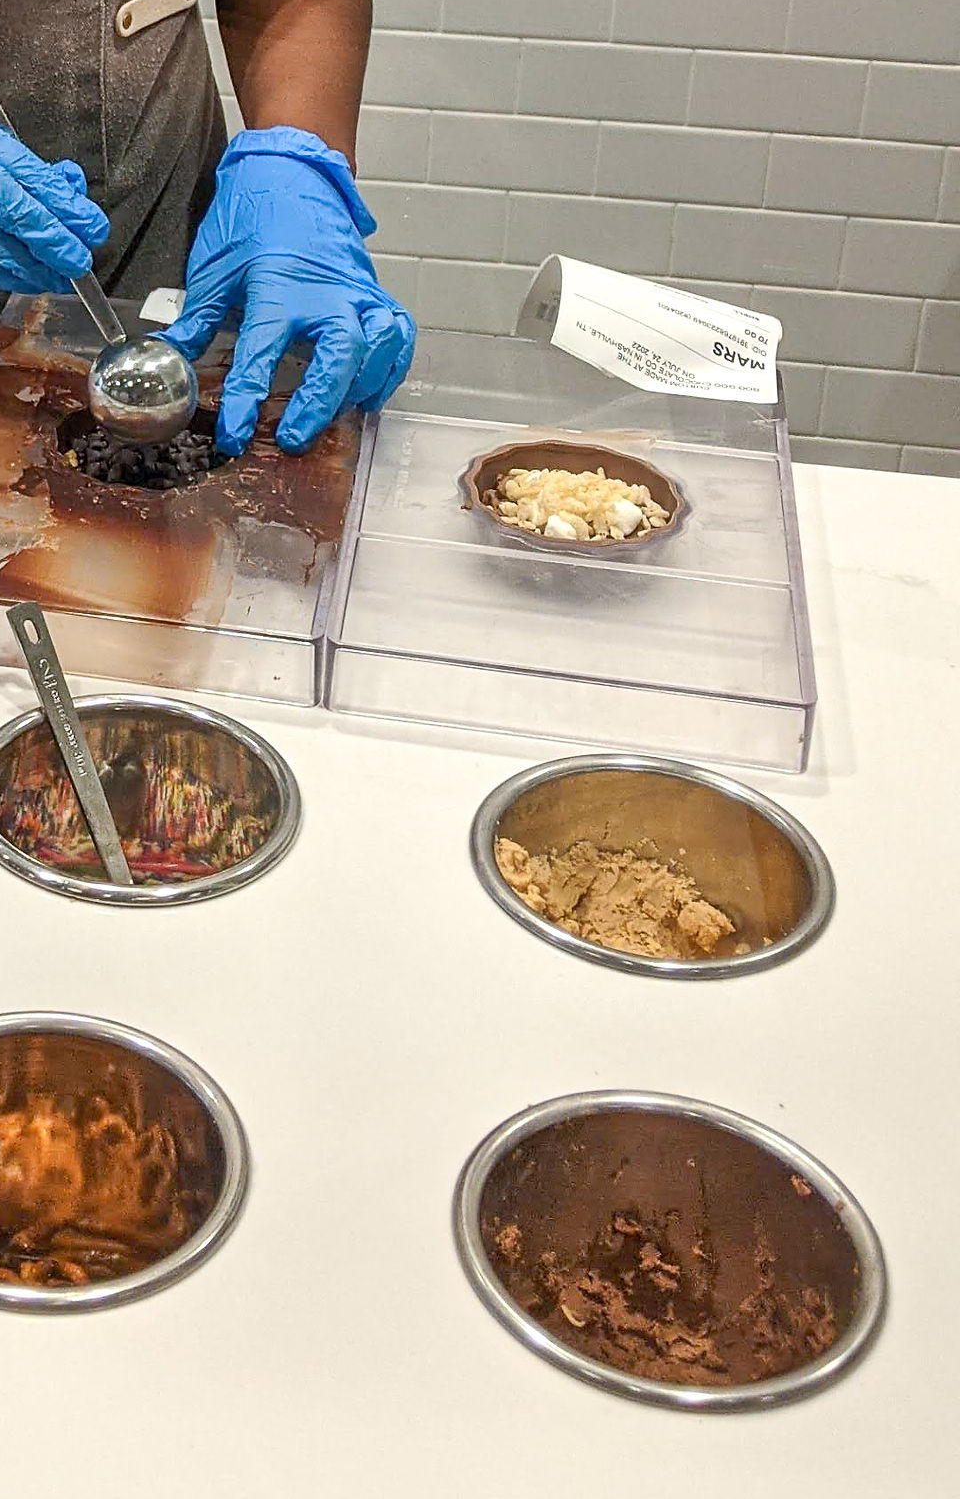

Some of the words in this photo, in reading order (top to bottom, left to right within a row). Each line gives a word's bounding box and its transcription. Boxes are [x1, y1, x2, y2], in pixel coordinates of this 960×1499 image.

[575, 321, 587, 332] TN
[758, 335, 769, 345] TO
[631, 341, 650, 356] 2022
[617, 352, 632, 366] THE
[634, 352, 643, 361] IN
[712, 341, 765, 370] MARS
[633, 363, 644, 372] AT
[662, 360, 682, 373] JULY
[644, 368, 668, 385] MADE
[682, 370, 696, 380] ON
